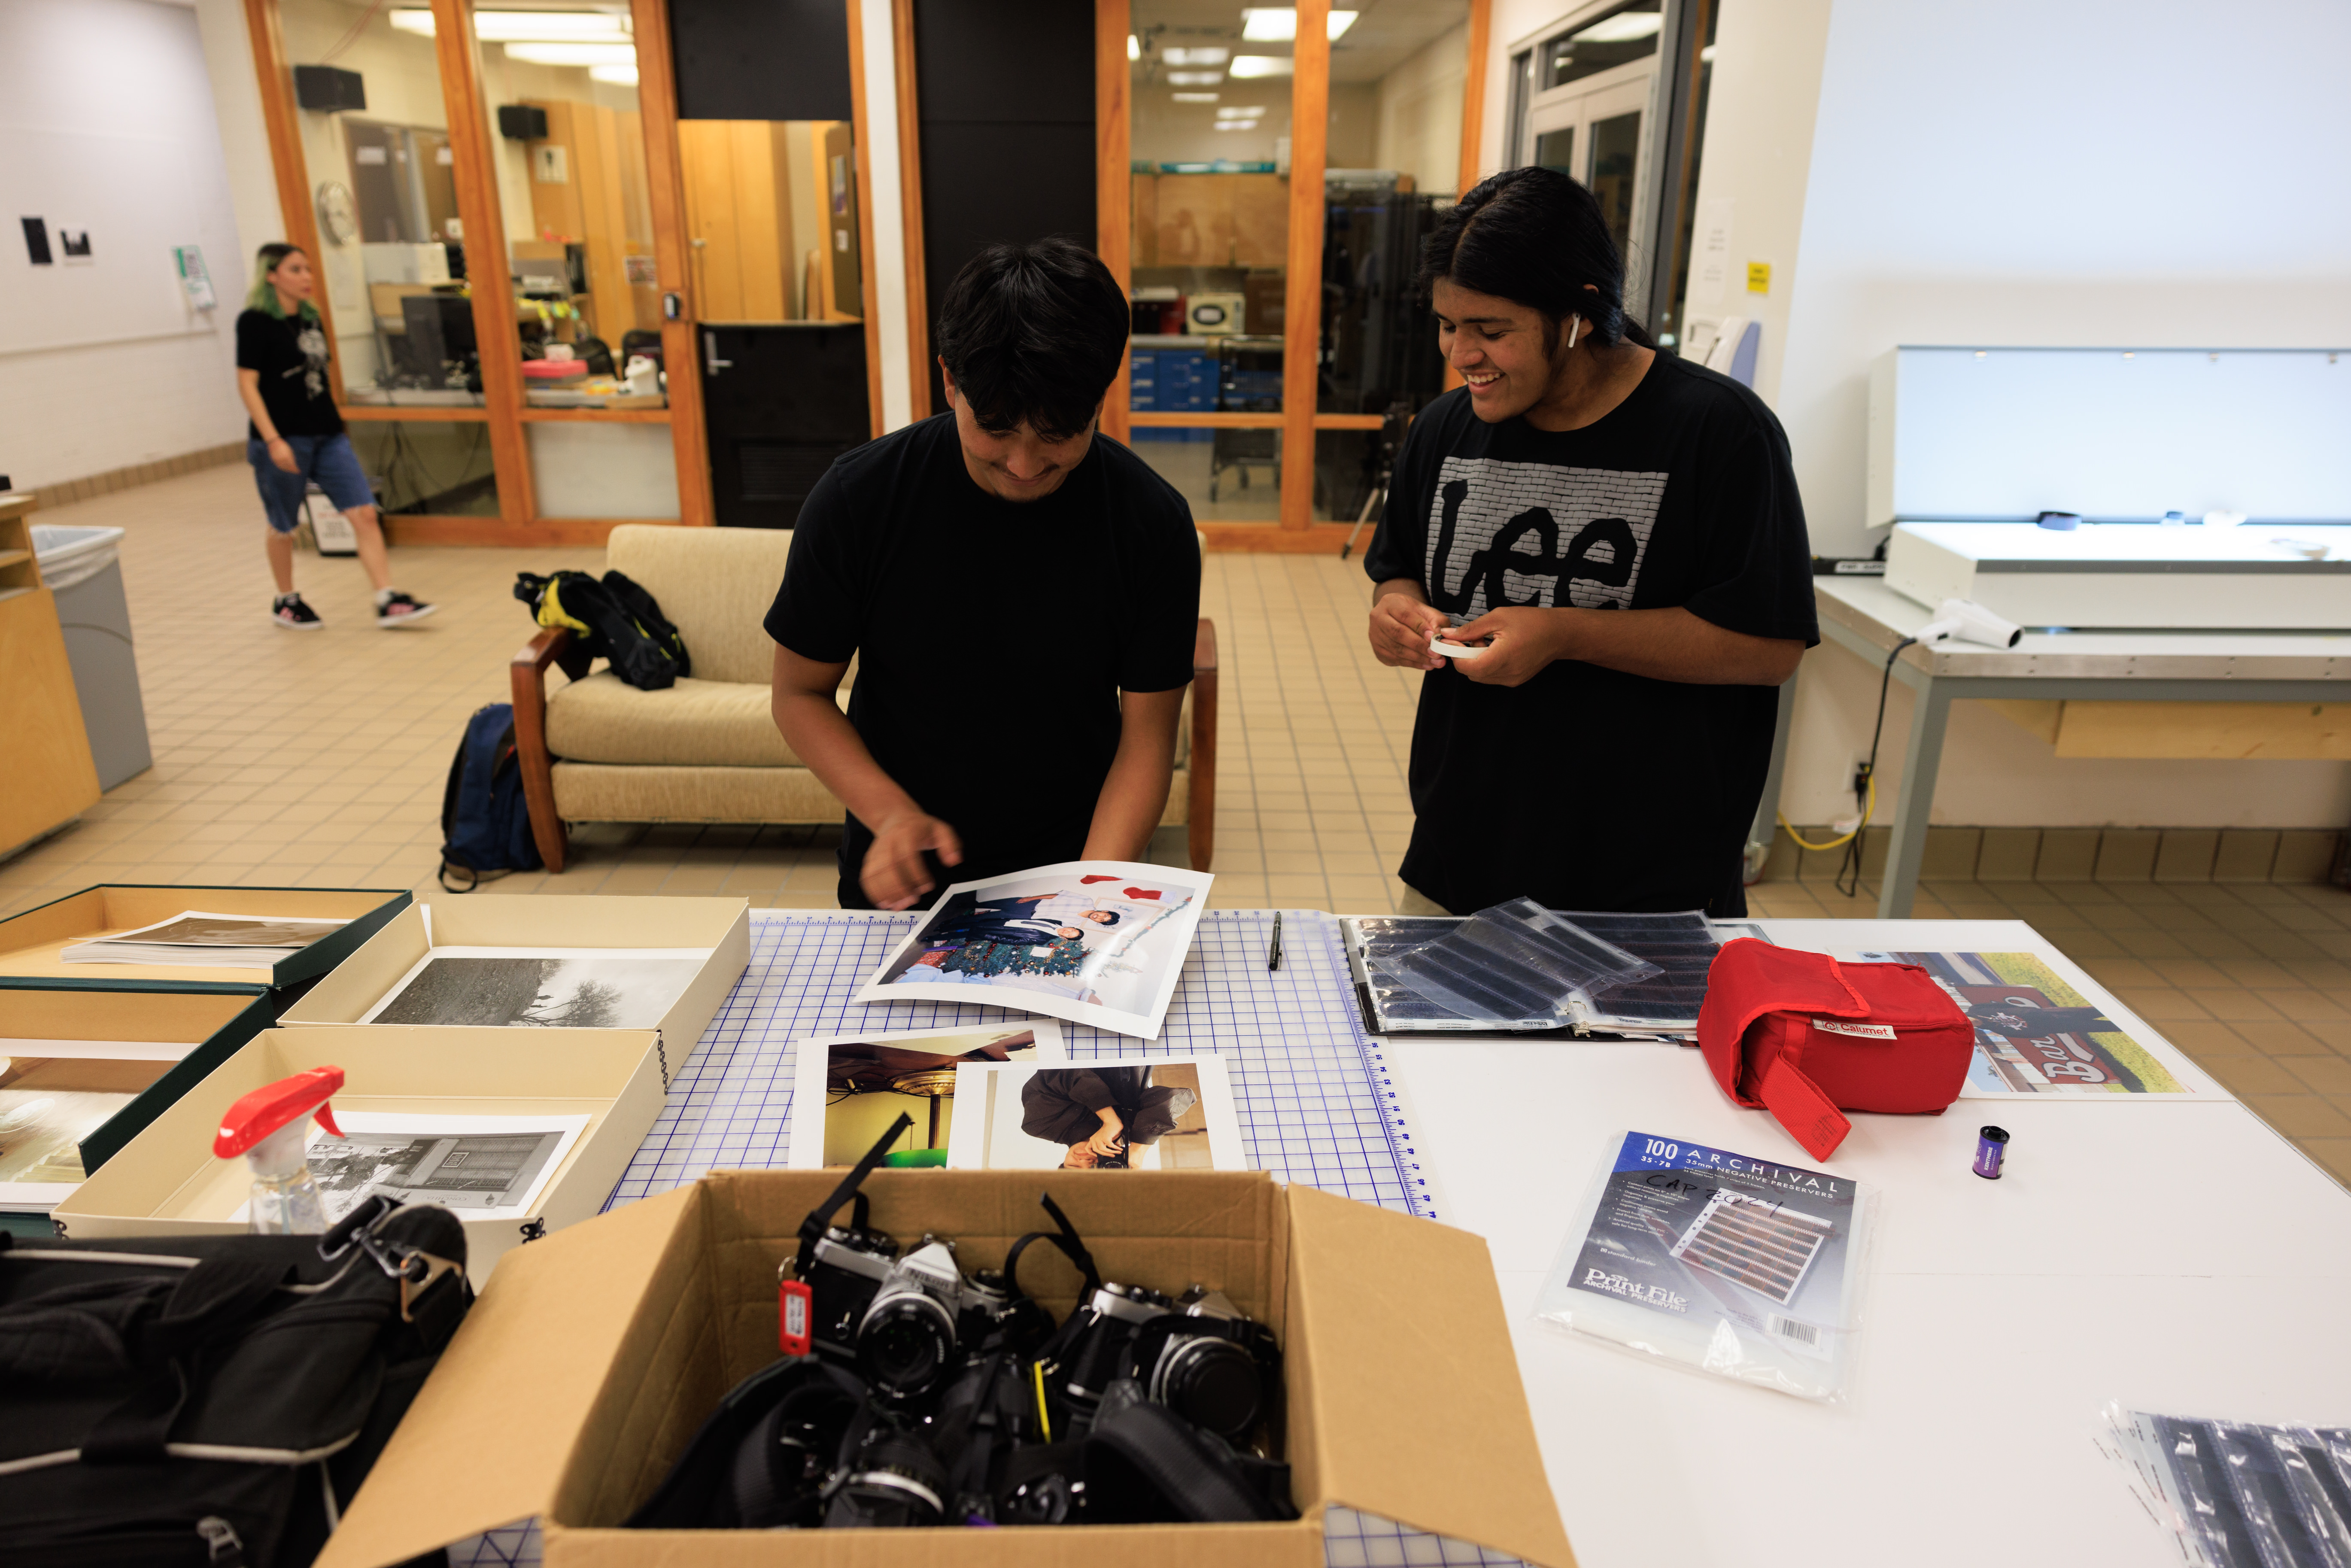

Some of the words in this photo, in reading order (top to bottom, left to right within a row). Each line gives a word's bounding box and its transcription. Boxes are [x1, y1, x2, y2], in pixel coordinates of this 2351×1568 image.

[1431, 479, 1637, 617] Lee
[1841, 1024, 1889, 1035] Calumet
[1645, 1139, 1678, 1159] 100
[1687, 1149, 1838, 1192] ARCHIVAL
[1686, 1158, 1713, 1169] 35mm
[1717, 1166, 1768, 1183] NEGATIVE
[1771, 1180, 1834, 1198] PRESERVERS
[1984, 1147, 1993, 1170] KENTMERE
[1646, 1175, 1698, 1196] CAP
[1706, 1189, 1784, 1217] 2024
[1607, 1250, 1635, 1260] standard
[1636, 1258, 1656, 1267] binder
[1583, 1280, 1627, 1295] ARCHIVAL
[1631, 1293, 1687, 1313] PRESERVERS
[1585, 1267, 1645, 1295] Print
[1646, 1285, 1688, 1307] File
